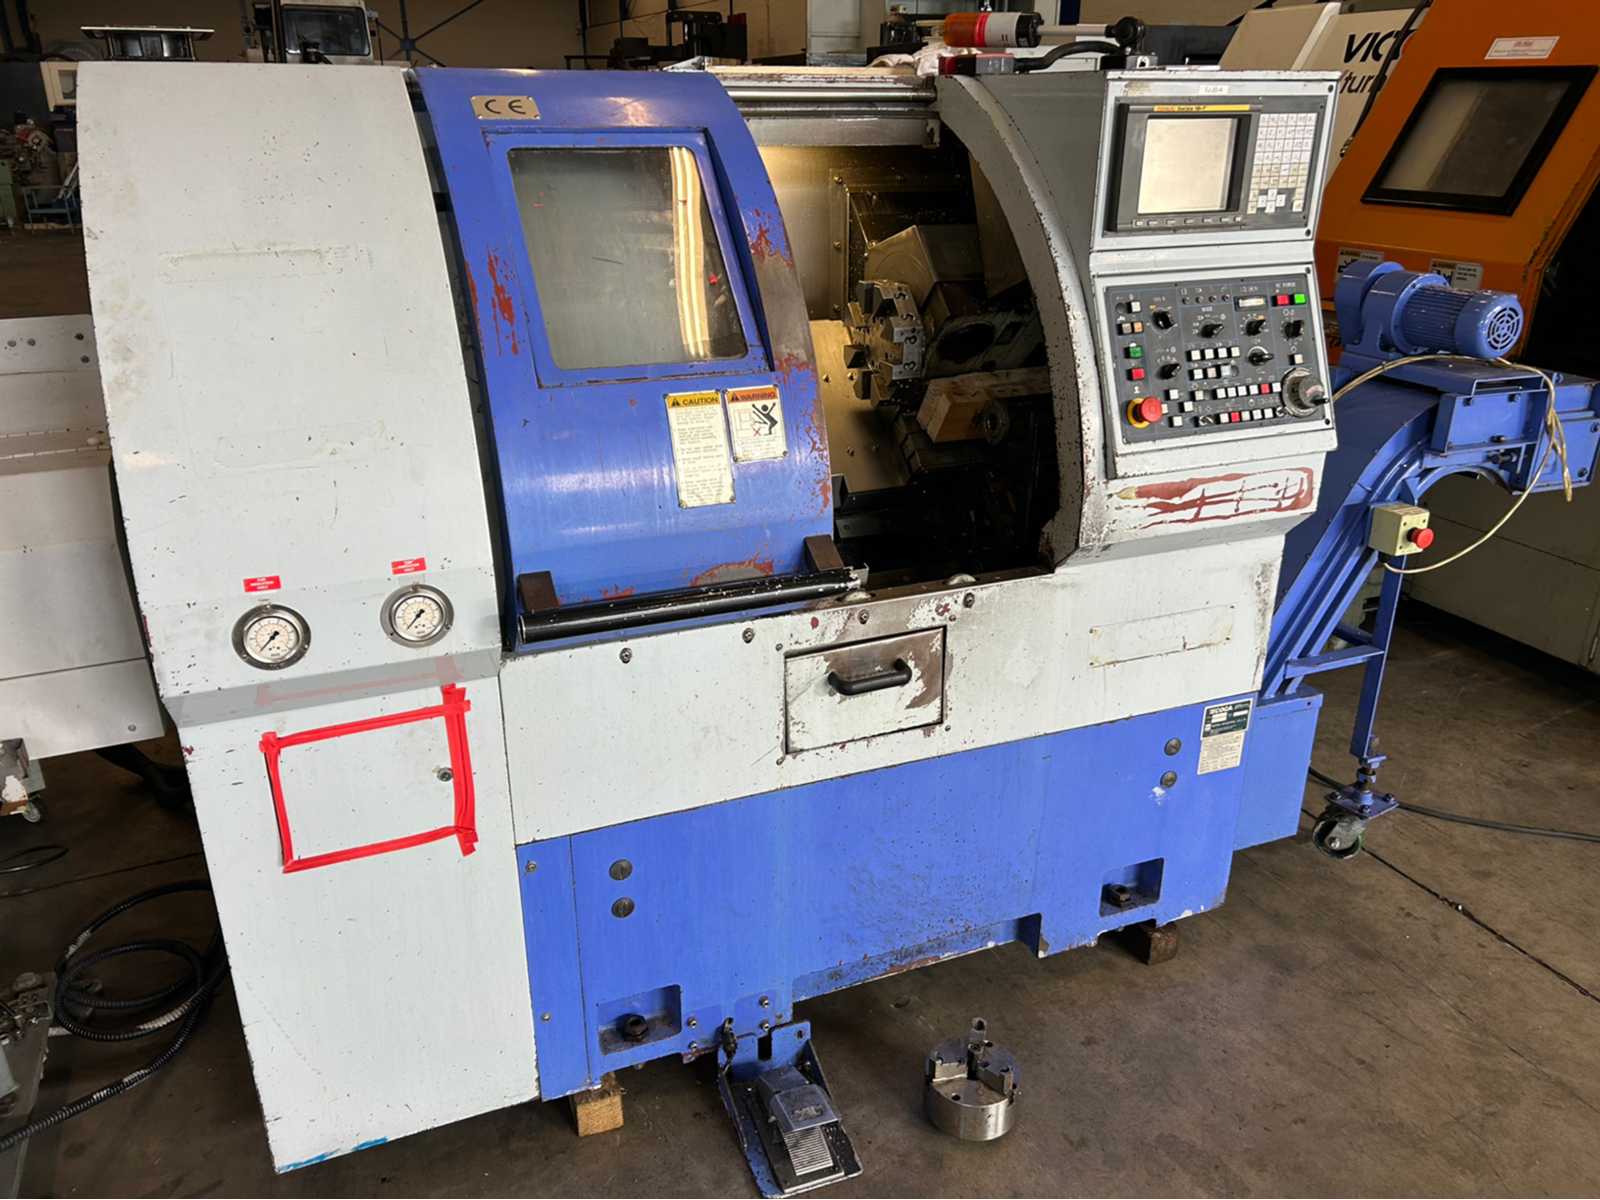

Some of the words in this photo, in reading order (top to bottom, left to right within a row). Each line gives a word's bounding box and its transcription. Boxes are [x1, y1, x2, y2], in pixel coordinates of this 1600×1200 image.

[484, 98, 526, 115] CE
[903, 360, 916, 370] 3
[682, 396, 719, 407] CAUTION
[739, 391, 777, 402] WARNING
